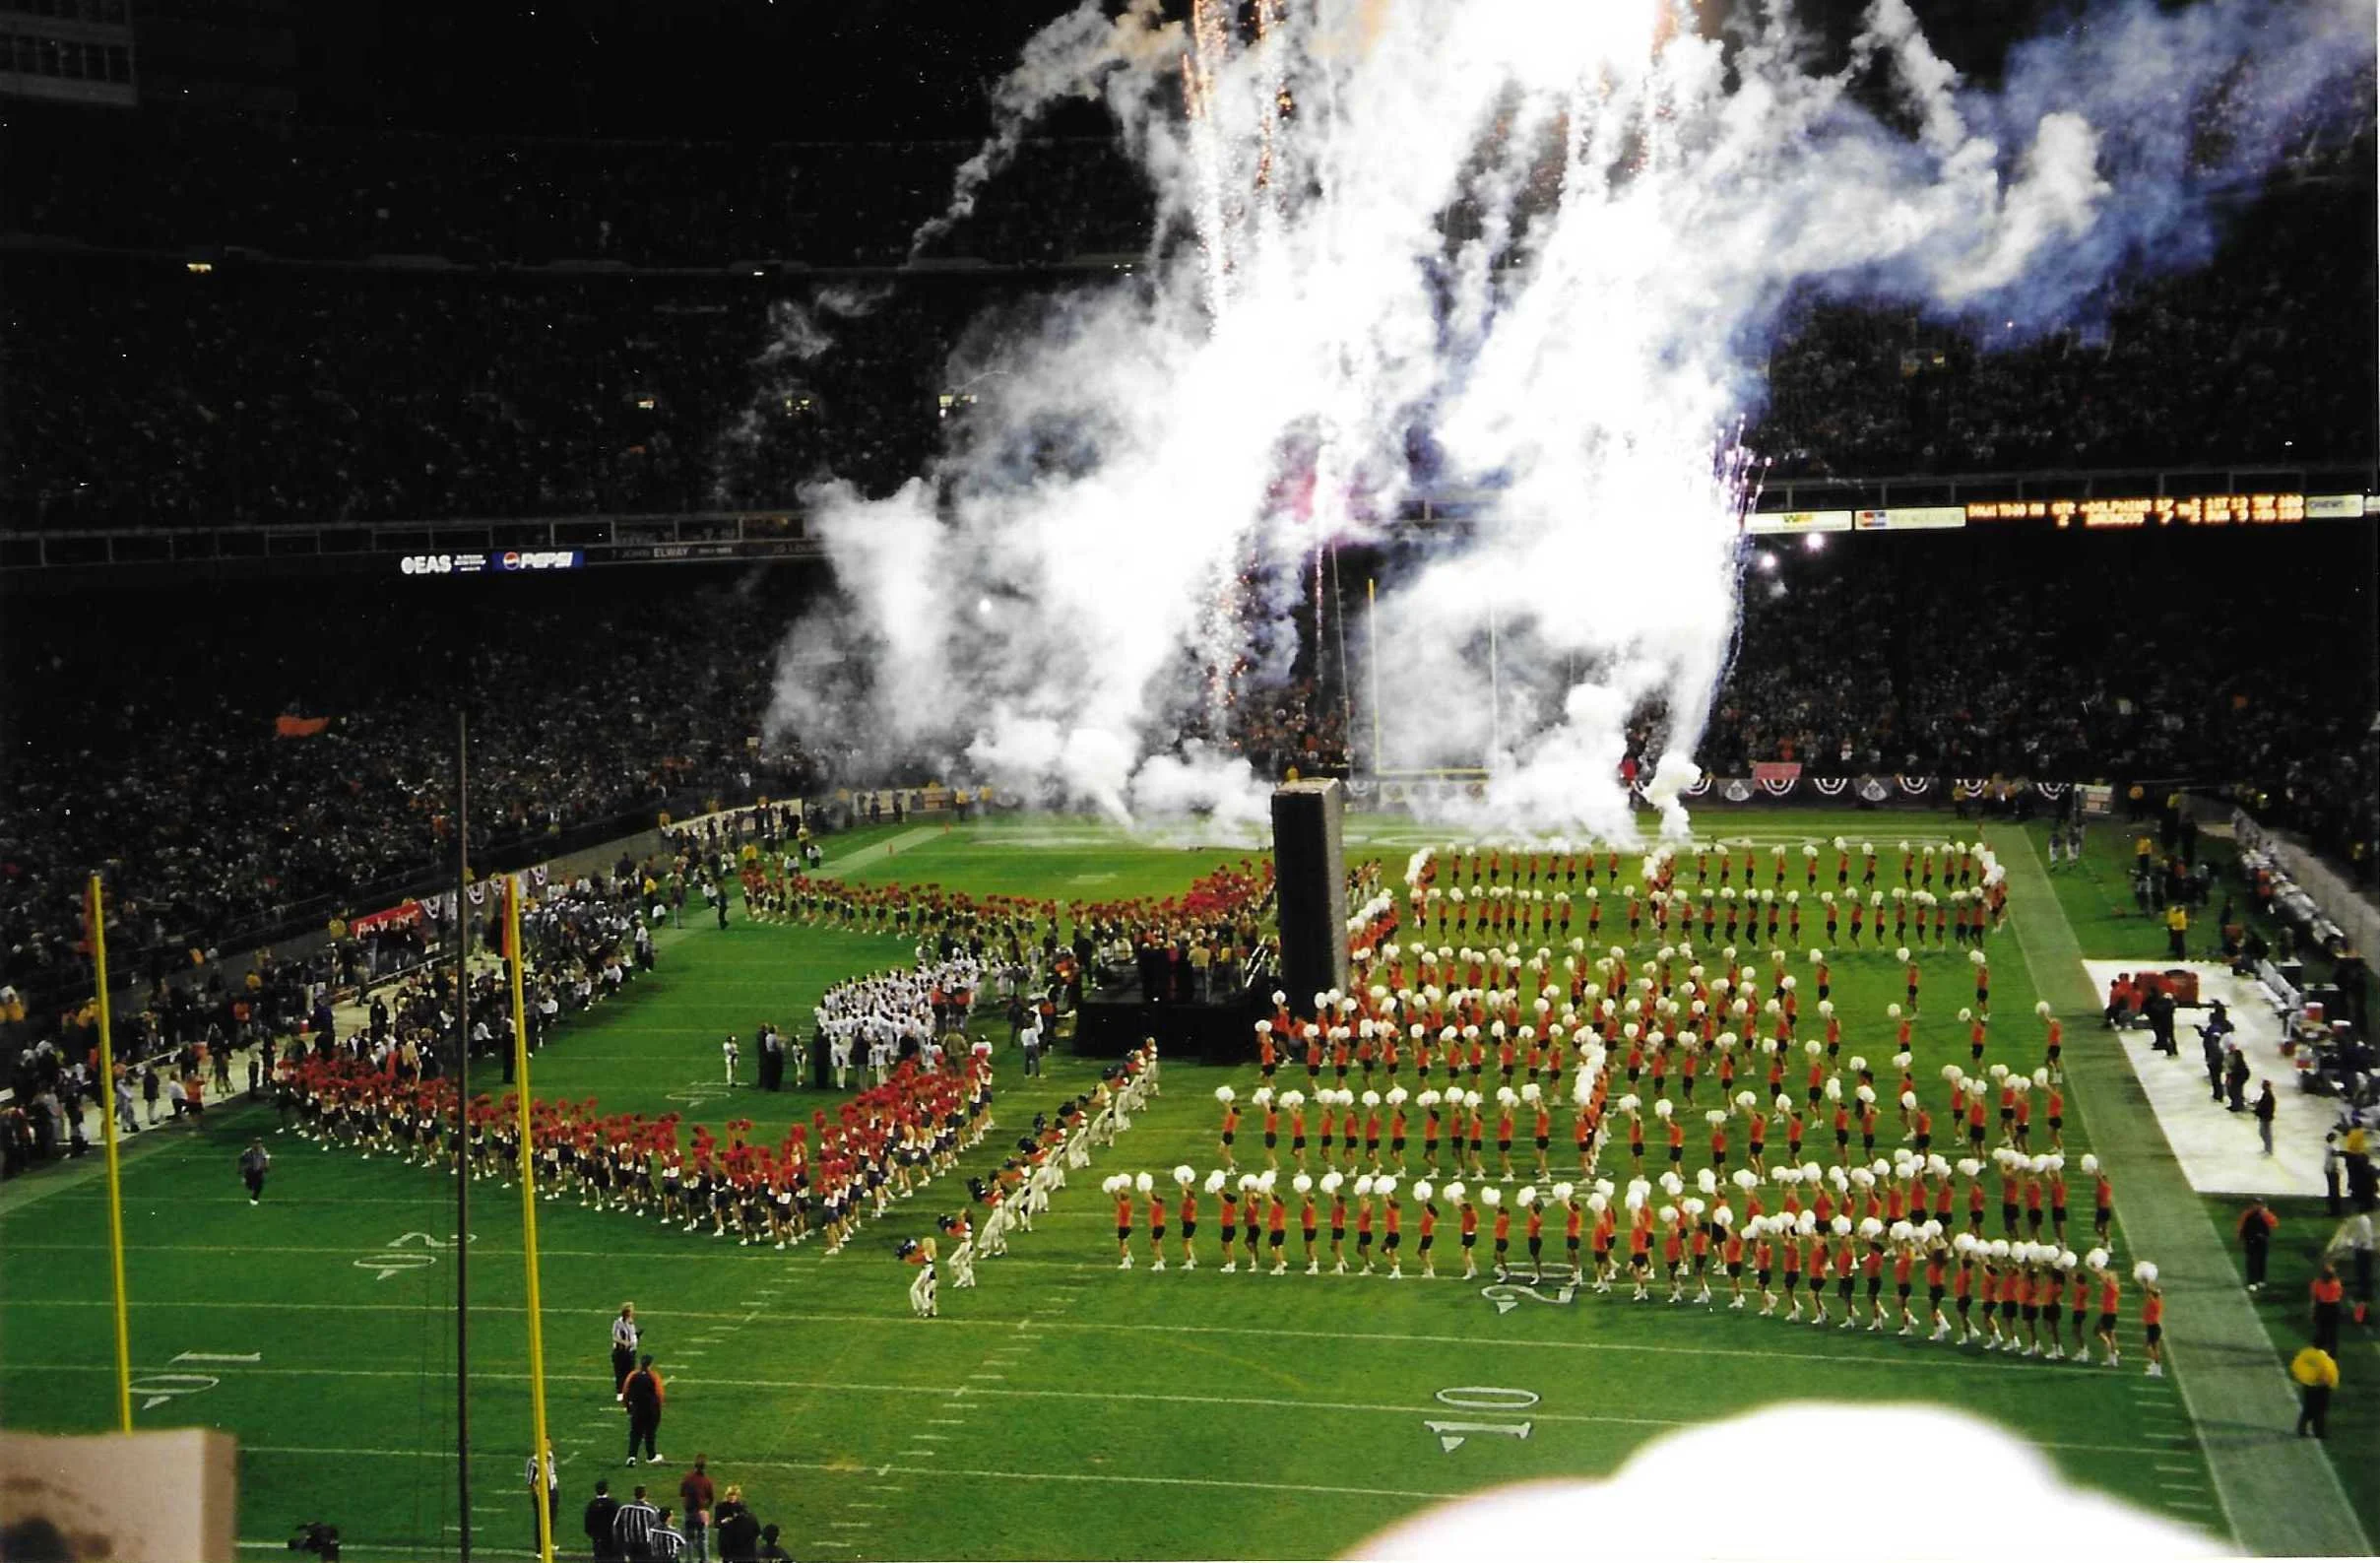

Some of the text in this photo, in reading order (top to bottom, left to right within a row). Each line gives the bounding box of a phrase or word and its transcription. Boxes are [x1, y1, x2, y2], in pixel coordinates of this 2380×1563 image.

[520, 552, 573, 568] PEPSI
[653, 548, 690, 558] ELWAY
[126, 1349, 261, 1395] 10
[1423, 1386, 1540, 1440] 10
